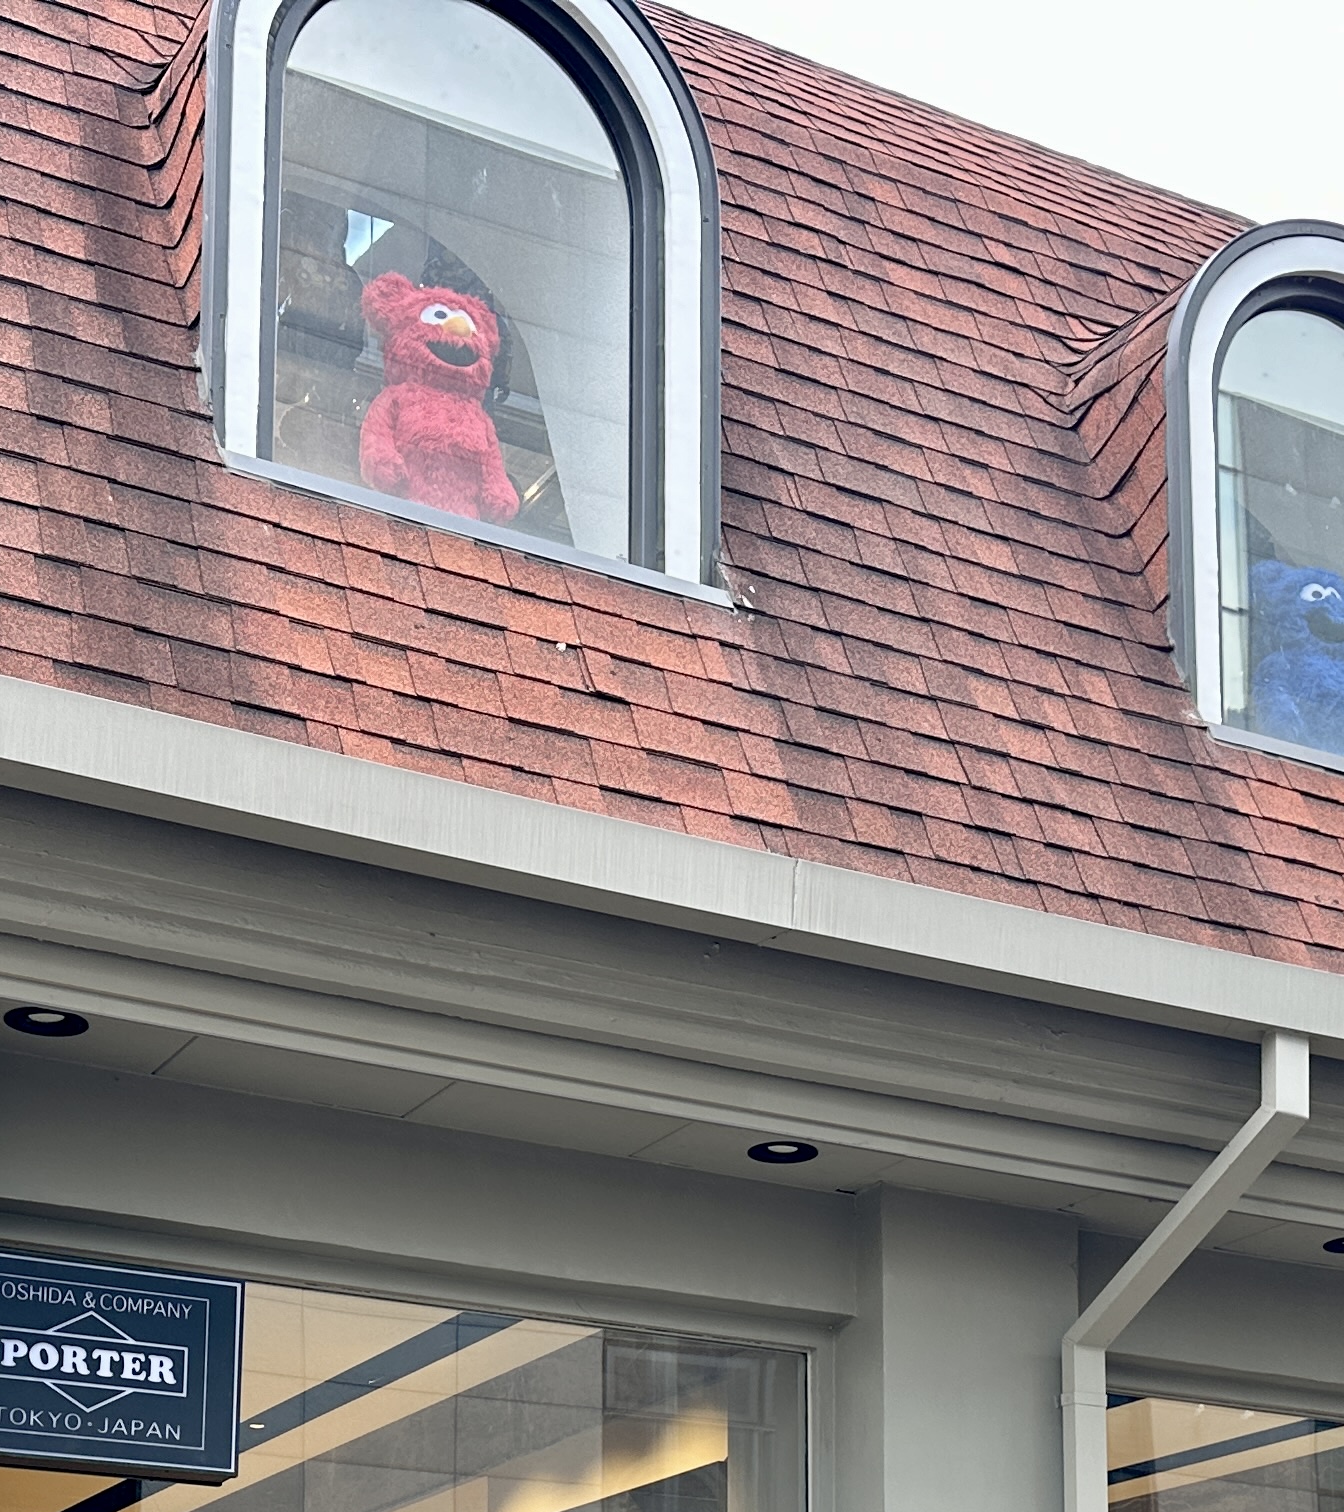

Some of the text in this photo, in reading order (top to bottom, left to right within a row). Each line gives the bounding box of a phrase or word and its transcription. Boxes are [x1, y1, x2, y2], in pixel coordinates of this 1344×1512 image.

[82, 1292, 97, 1309] &
[100, 1292, 193, 1320] COMPANY
[0, 1338, 177, 1385] PORTER
